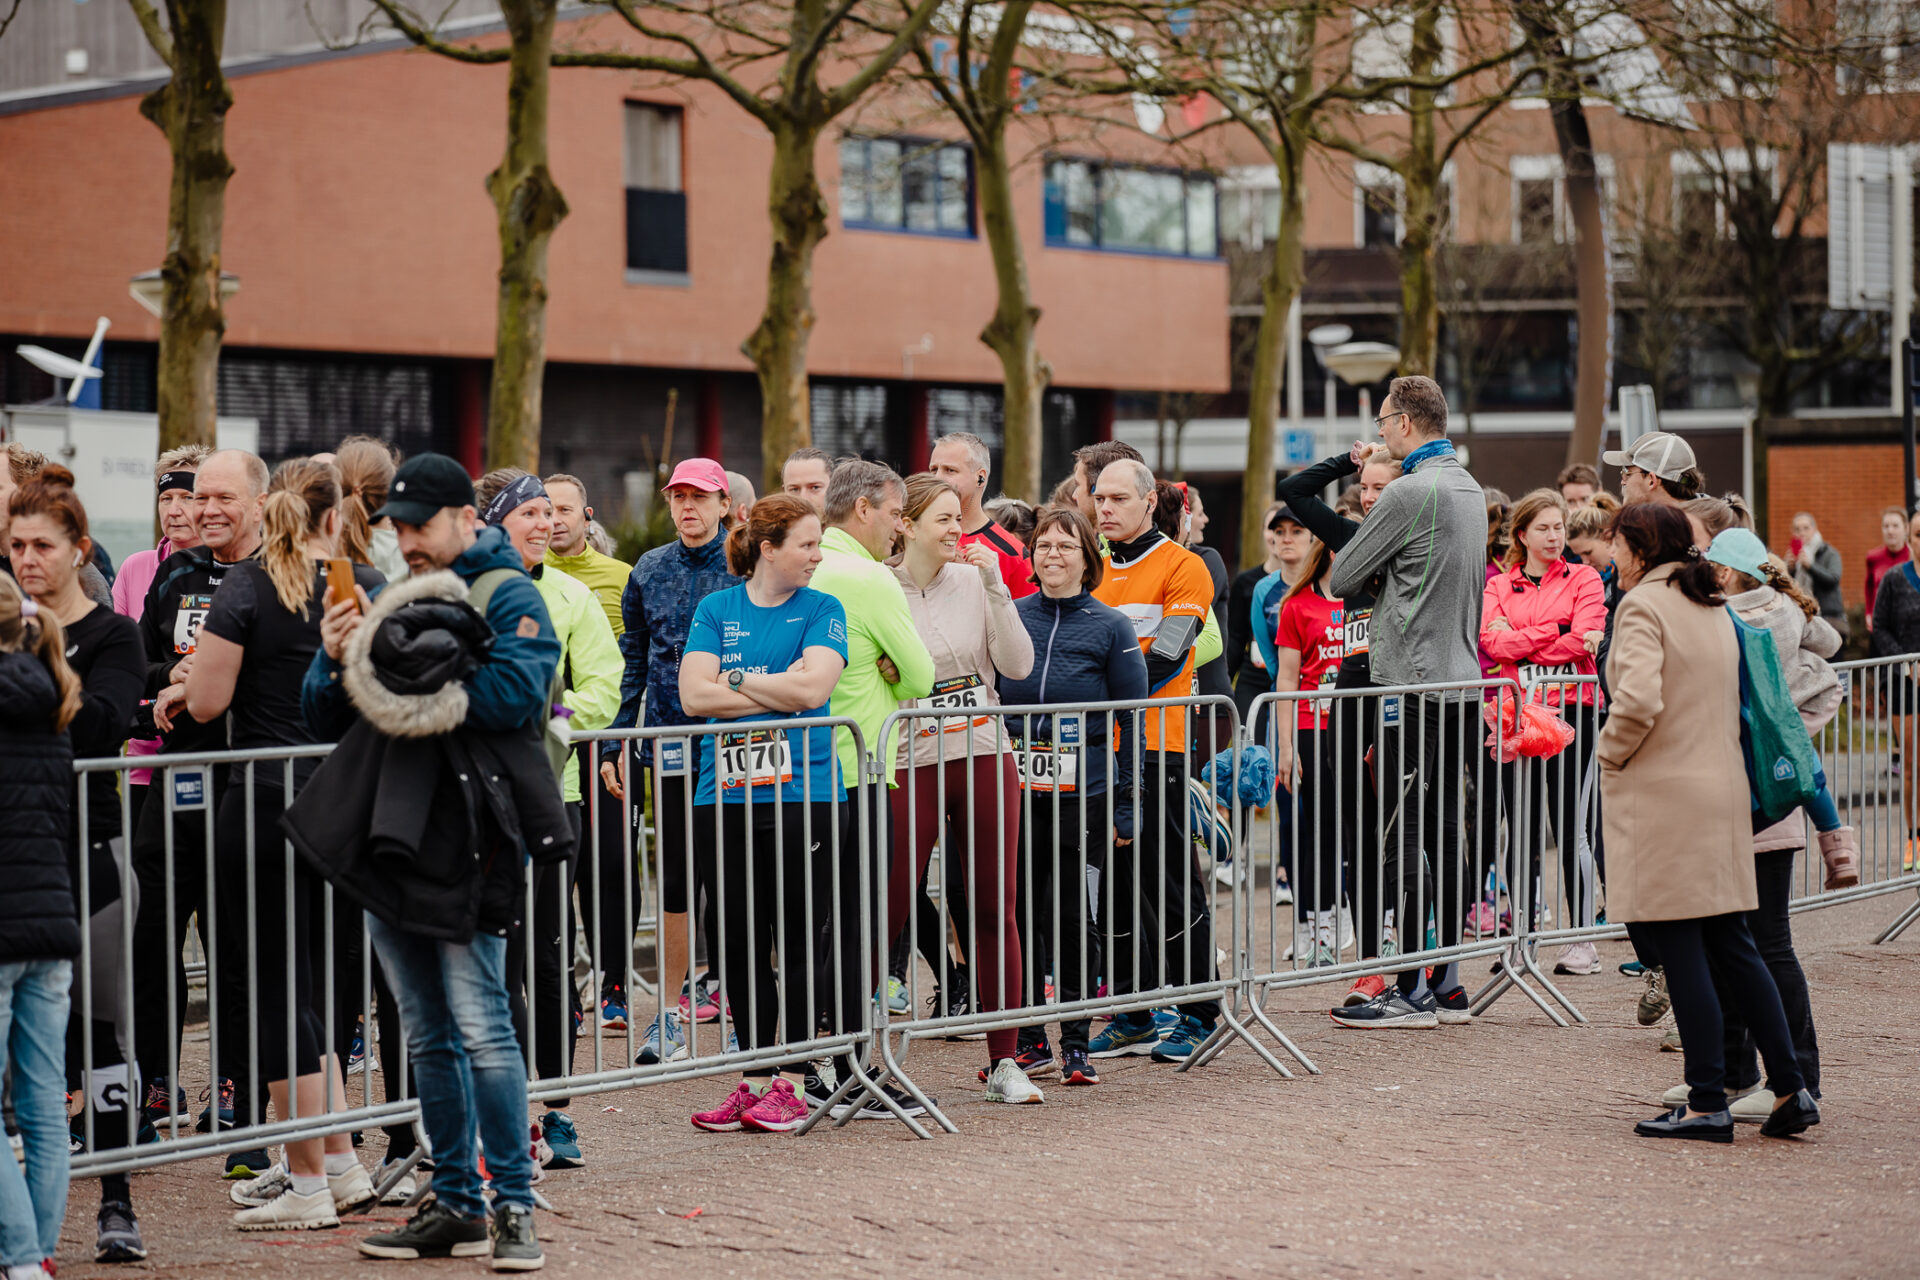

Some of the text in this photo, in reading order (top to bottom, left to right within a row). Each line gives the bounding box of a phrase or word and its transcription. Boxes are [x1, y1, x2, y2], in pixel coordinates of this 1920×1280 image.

[722, 652, 742, 664] RUN
[723, 744, 785, 773] 1070
[1018, 753, 1062, 777] 505
